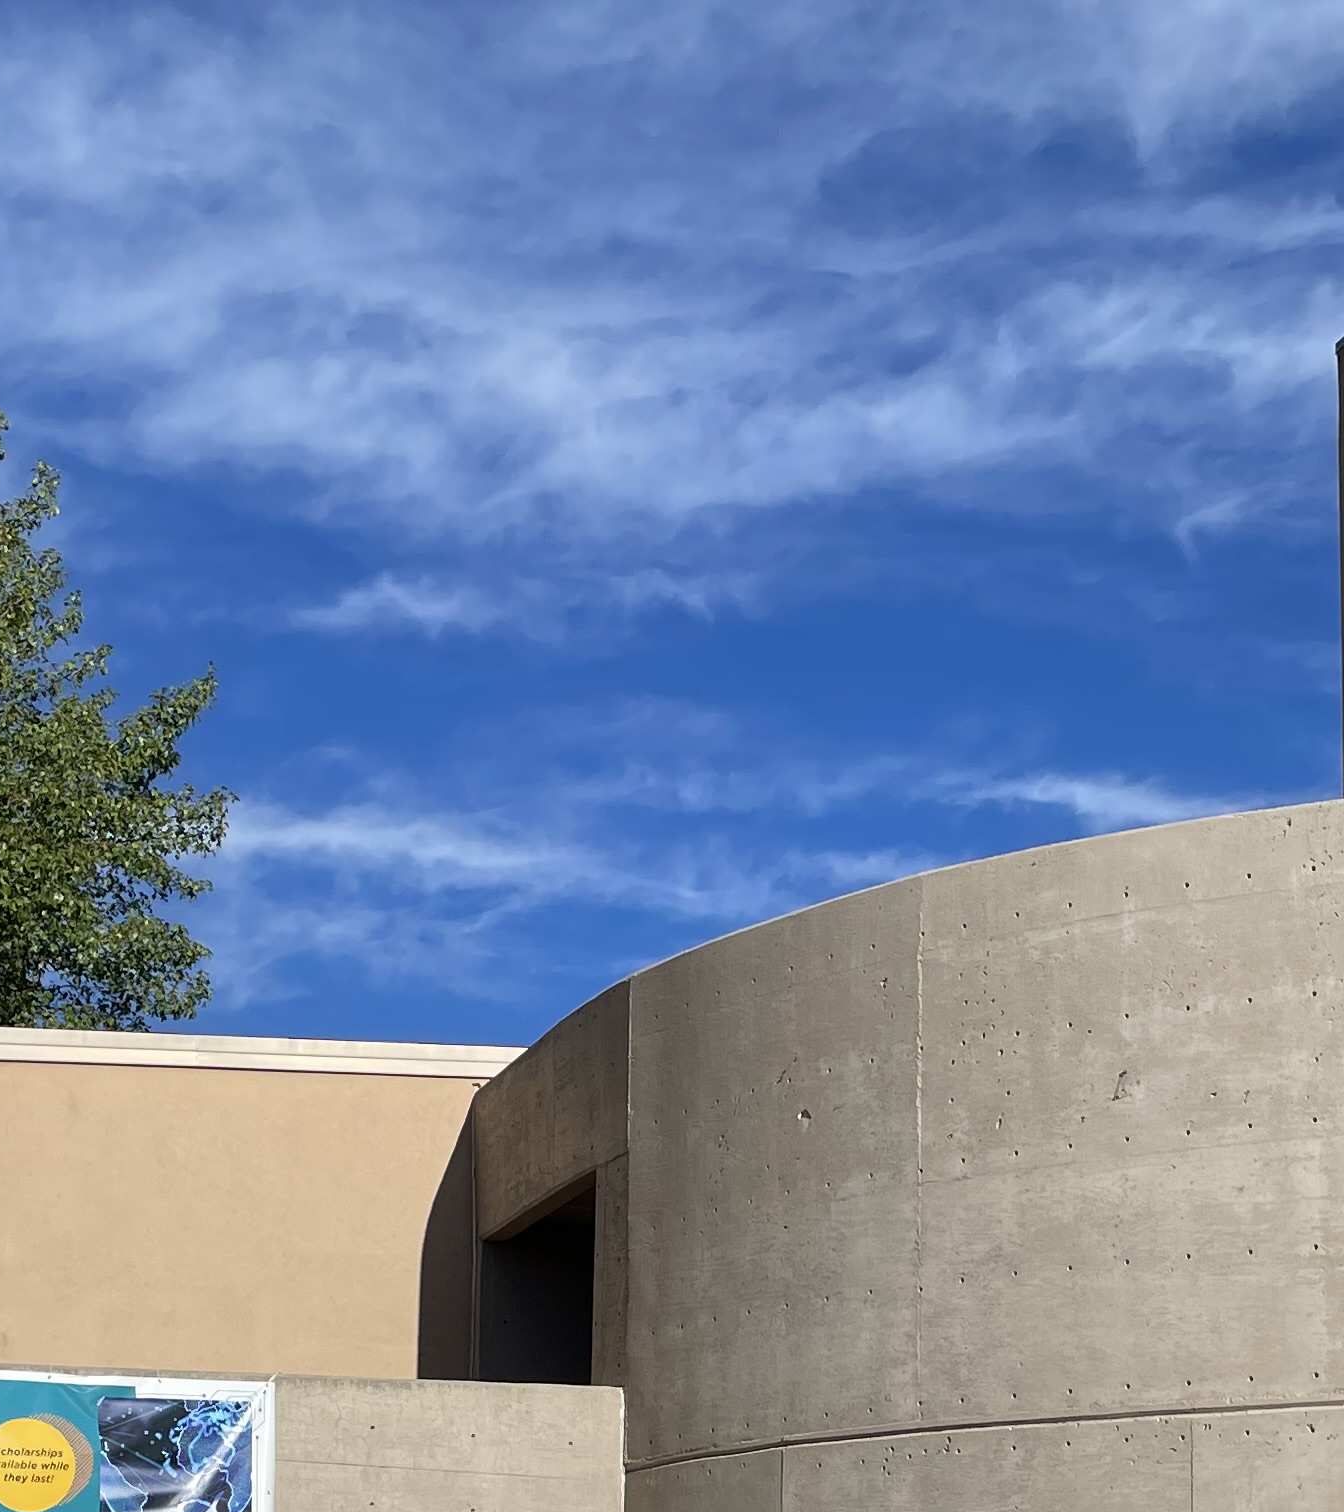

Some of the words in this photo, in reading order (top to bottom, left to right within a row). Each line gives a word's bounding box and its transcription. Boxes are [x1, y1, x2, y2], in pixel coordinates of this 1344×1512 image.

[40, 1461, 70, 1471] while
[3, 1473, 29, 1484] they
[31, 1473, 55, 1483] last!
